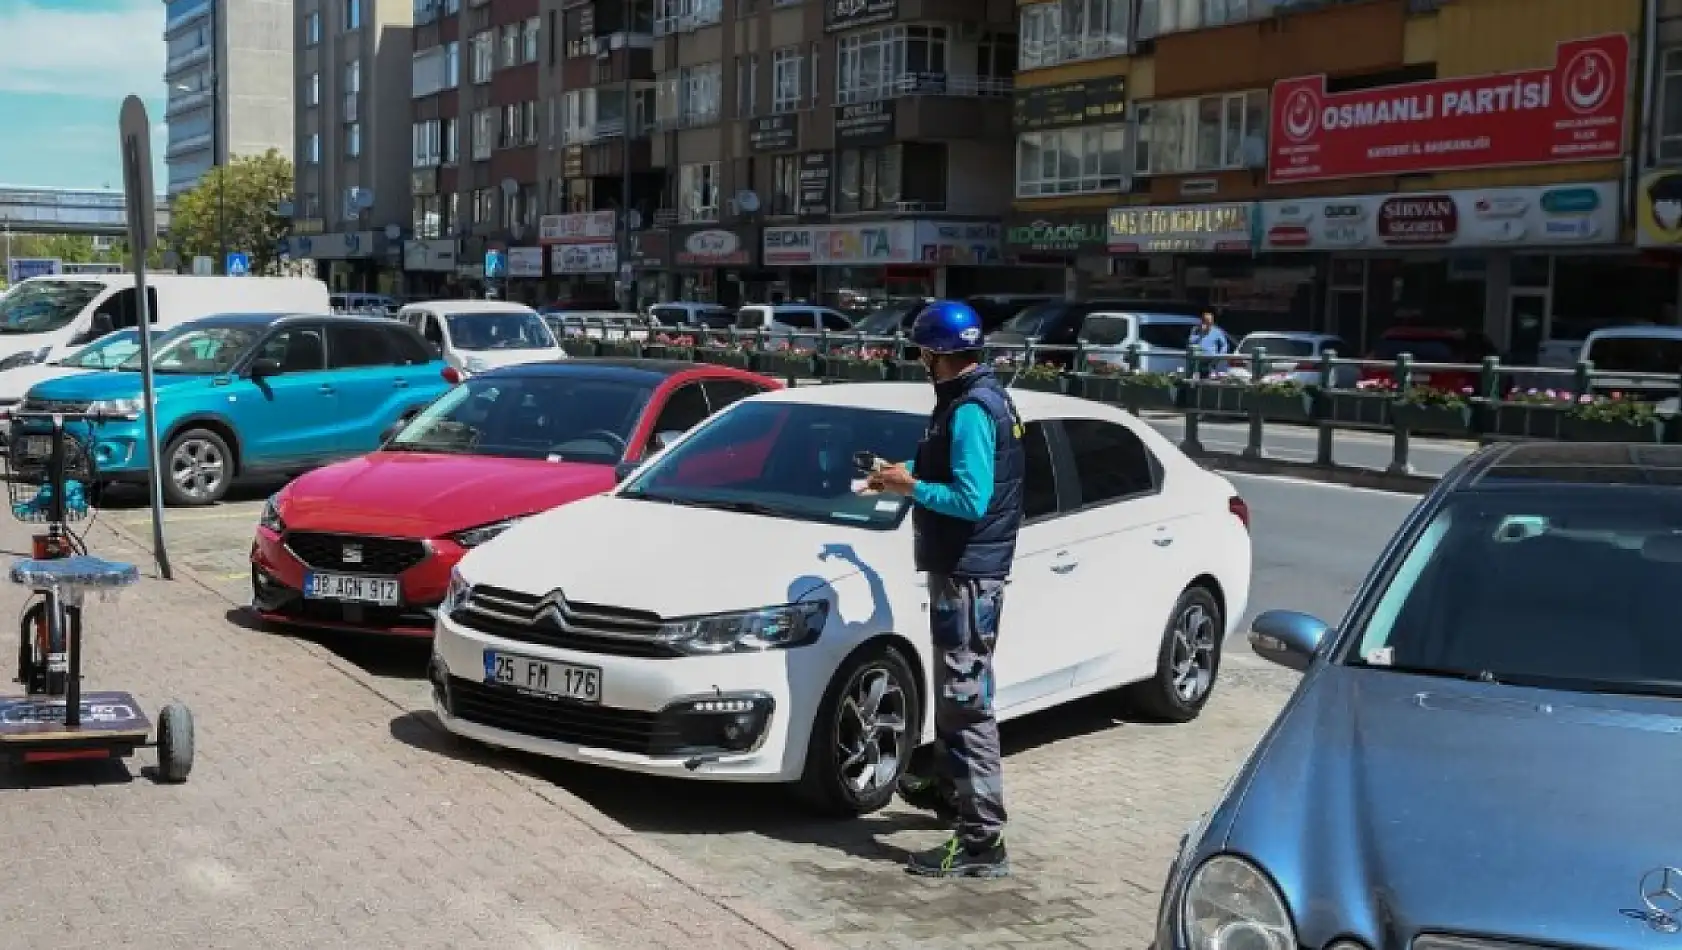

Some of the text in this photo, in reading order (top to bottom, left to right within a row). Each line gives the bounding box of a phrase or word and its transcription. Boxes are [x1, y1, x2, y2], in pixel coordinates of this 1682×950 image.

[1321, 75, 1550, 131] OSMANLI PARTİSİ
[496, 656, 514, 681] 25
[528, 661, 549, 688] FM
[564, 668, 596, 696] 176
